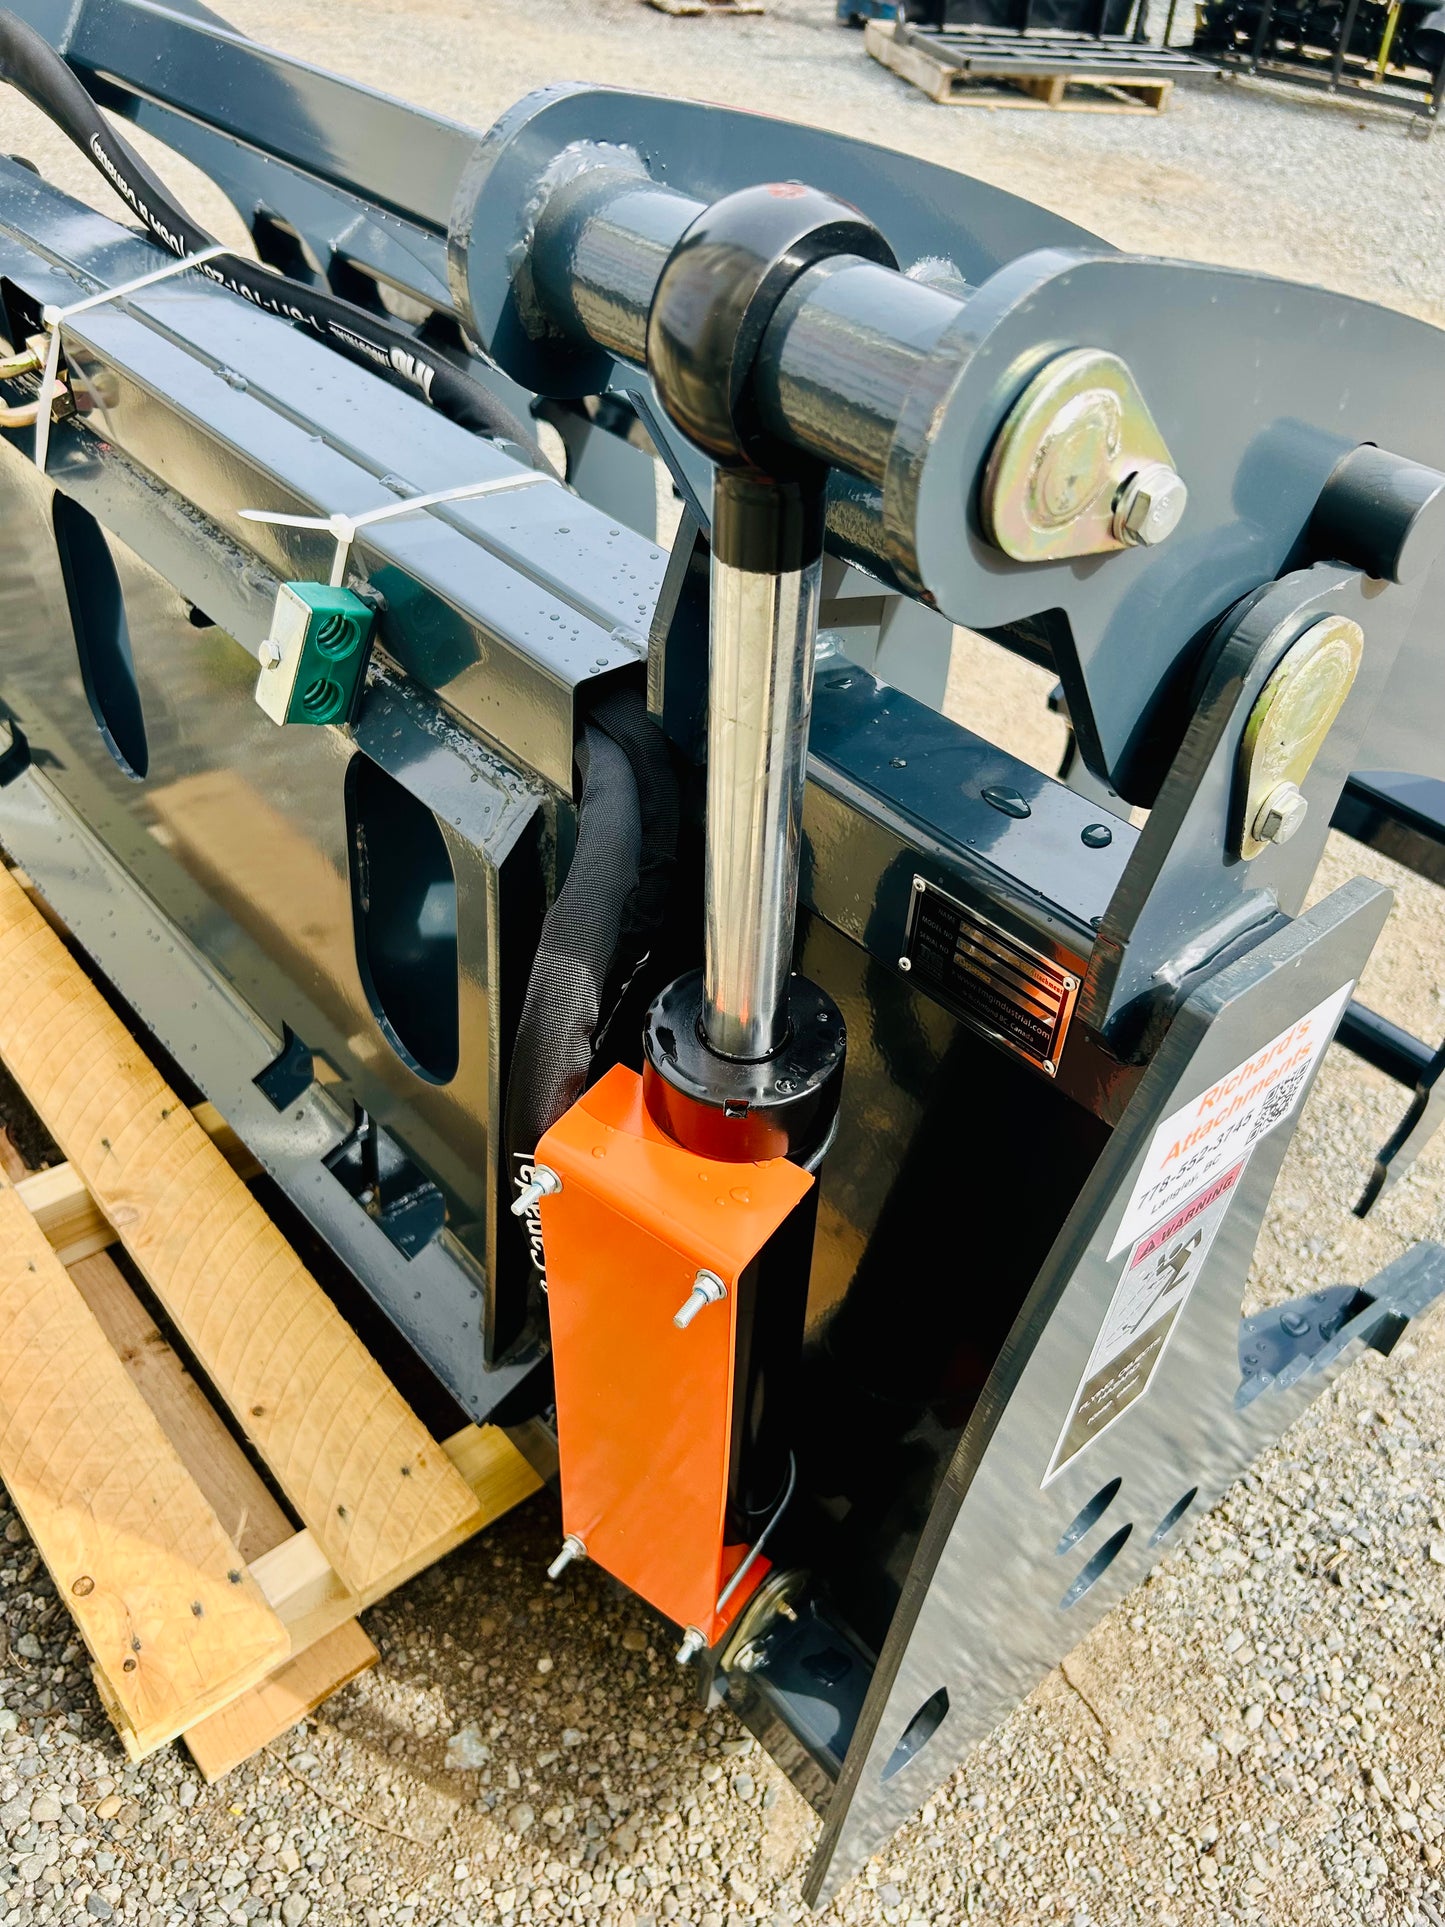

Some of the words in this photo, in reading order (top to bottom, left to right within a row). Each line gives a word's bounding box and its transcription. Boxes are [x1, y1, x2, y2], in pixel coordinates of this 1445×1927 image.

[919, 931, 939, 948] SERIAL
[921, 915, 943, 934] MODEL
[1010, 1022, 1035, 1043] Canada
[1197, 1019, 1312, 1119] Richard's
[1160, 1041, 1313, 1169] Attachments
[1137, 1110, 1253, 1210] 778-552-3745
[1151, 1172, 1200, 1215] Langley,
[1203, 1154, 1222, 1174] BC
[1161, 1174, 1234, 1240] WARNING
